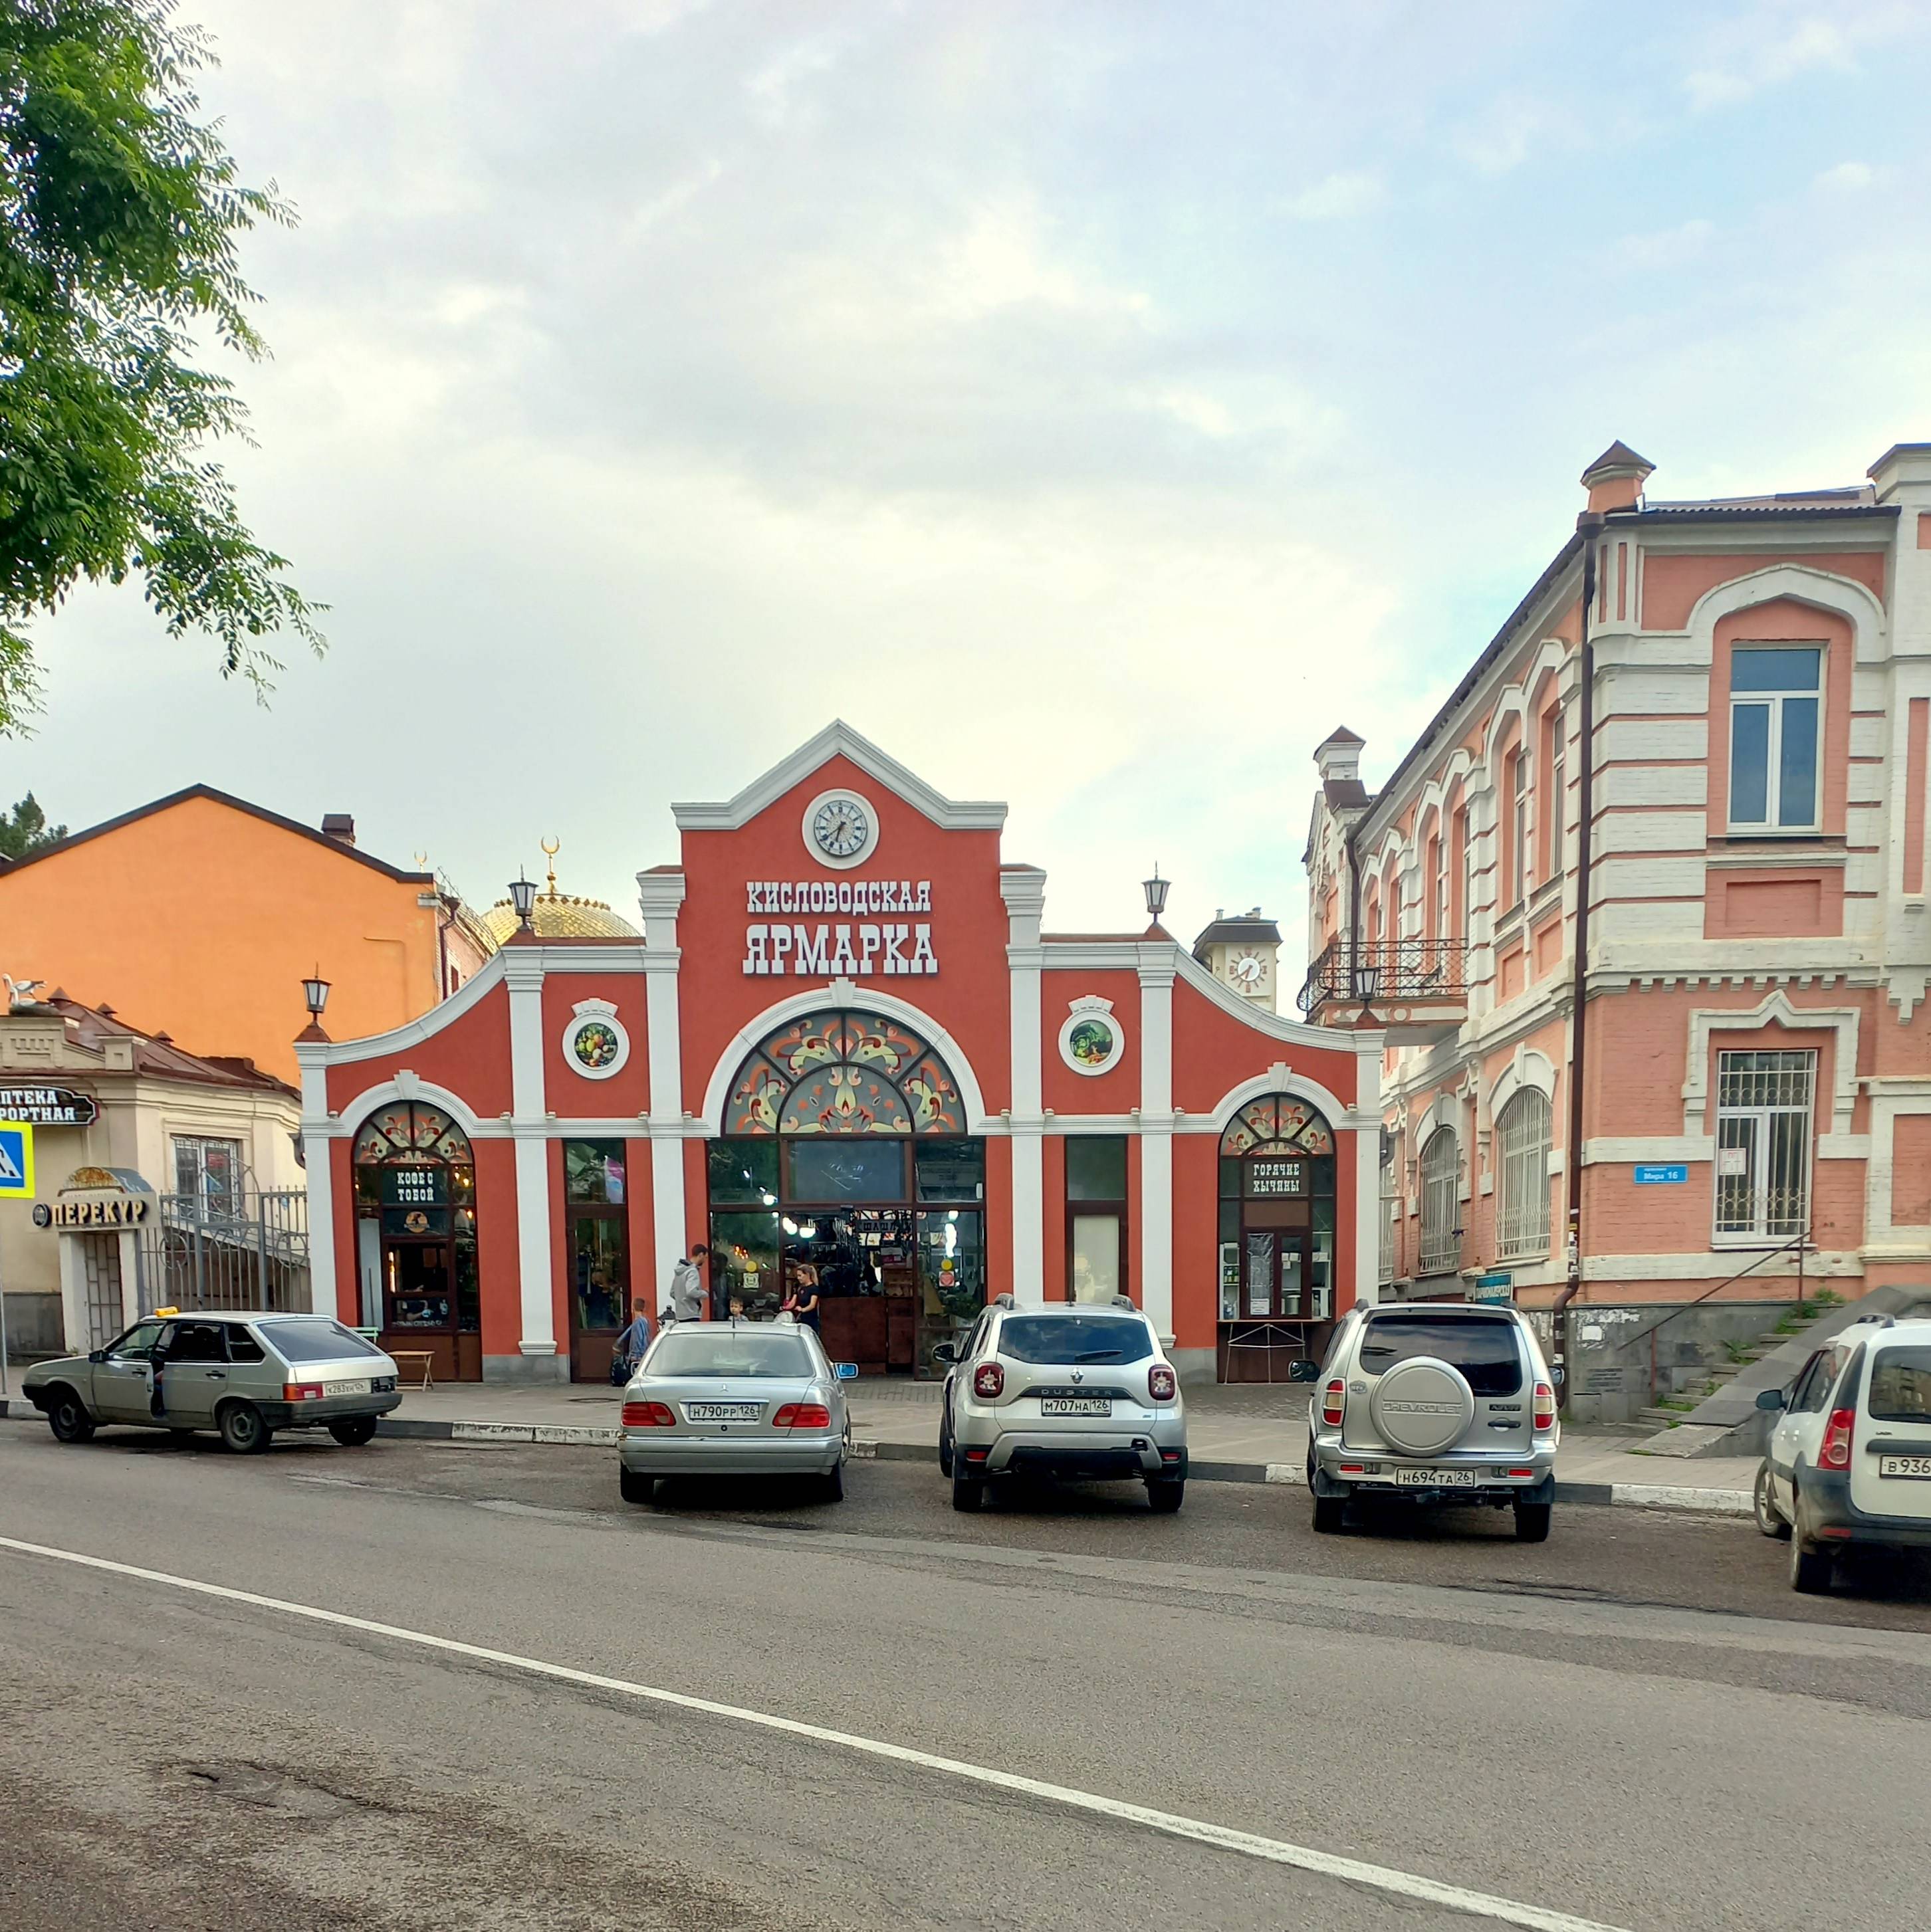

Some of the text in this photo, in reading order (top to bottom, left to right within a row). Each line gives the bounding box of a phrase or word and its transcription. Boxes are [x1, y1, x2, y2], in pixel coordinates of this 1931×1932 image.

[746, 881, 931, 916] КИСЛОВОДСКАЯ
[742, 924, 938, 974] ЯРМАРКА
[1253, 1163, 1300, 1176] ГОРЯЧИЕ
[1667, 1171, 1678, 1180] 16
[396, 1172, 433, 1185] КОФЕ С
[397, 1187, 434, 1202] ТОБОЙ
[51, 1200, 144, 1226] ПЕРЕКУР
[693, 1405, 756, 1417] Н790РР 126
[1045, 1400, 1108, 1412] М707НА 126
[1888, 1458, 1931, 1473] В936
[1403, 1471, 1470, 1484] Н694ТА 26
